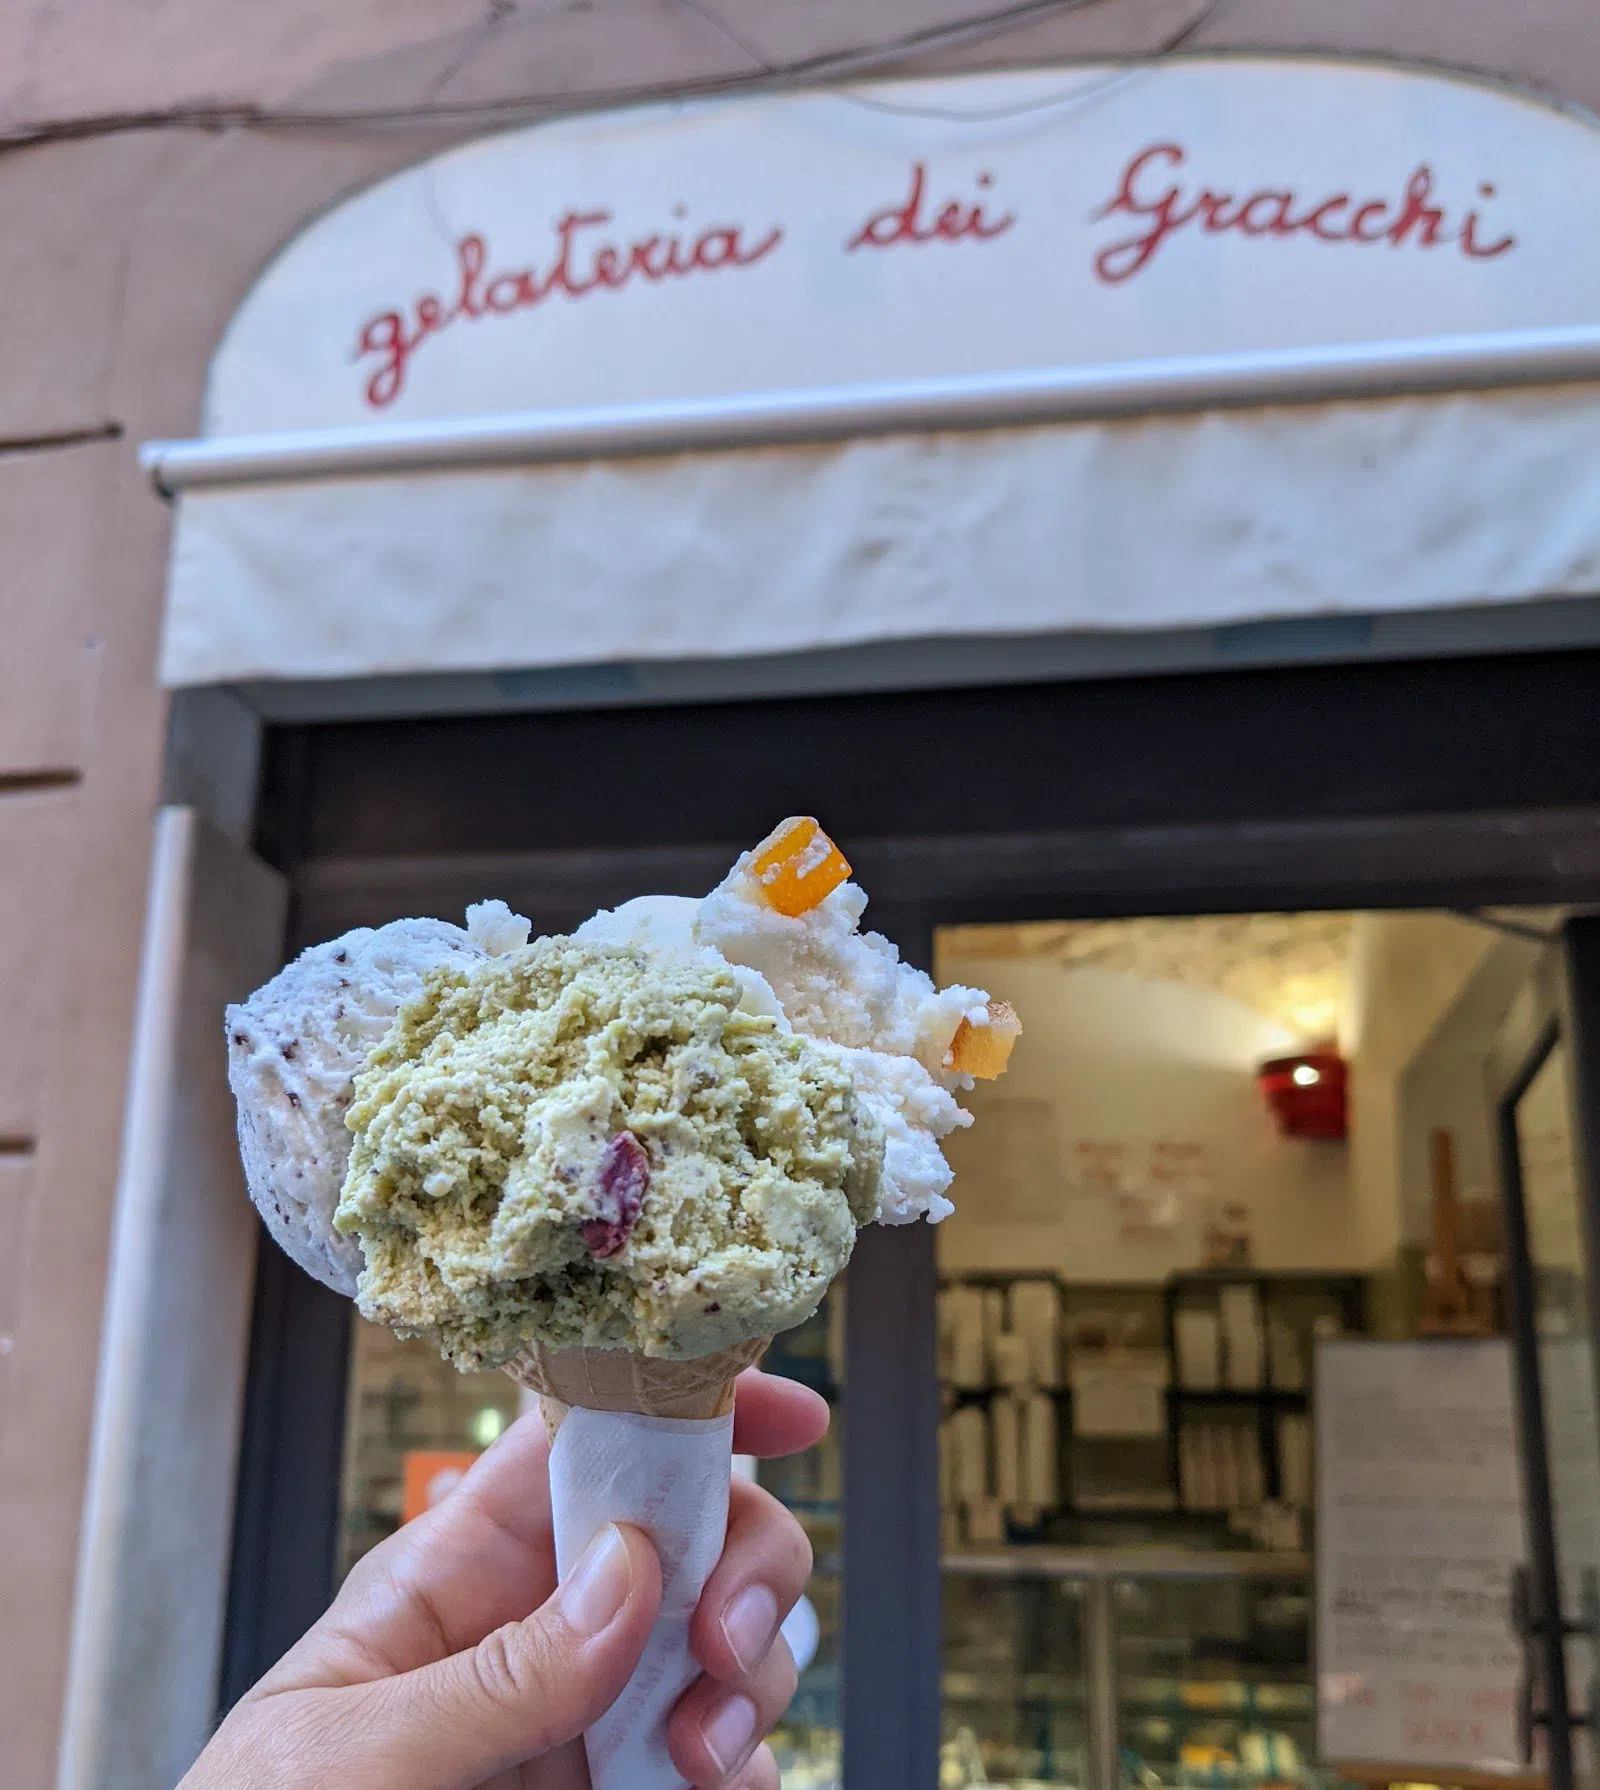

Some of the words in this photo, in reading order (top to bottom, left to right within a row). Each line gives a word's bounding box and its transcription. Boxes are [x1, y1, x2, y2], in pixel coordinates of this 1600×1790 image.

[350, 206, 785, 408] gelateria
[846, 162, 1014, 252] dei
[1093, 142, 1515, 284] Gracchi
